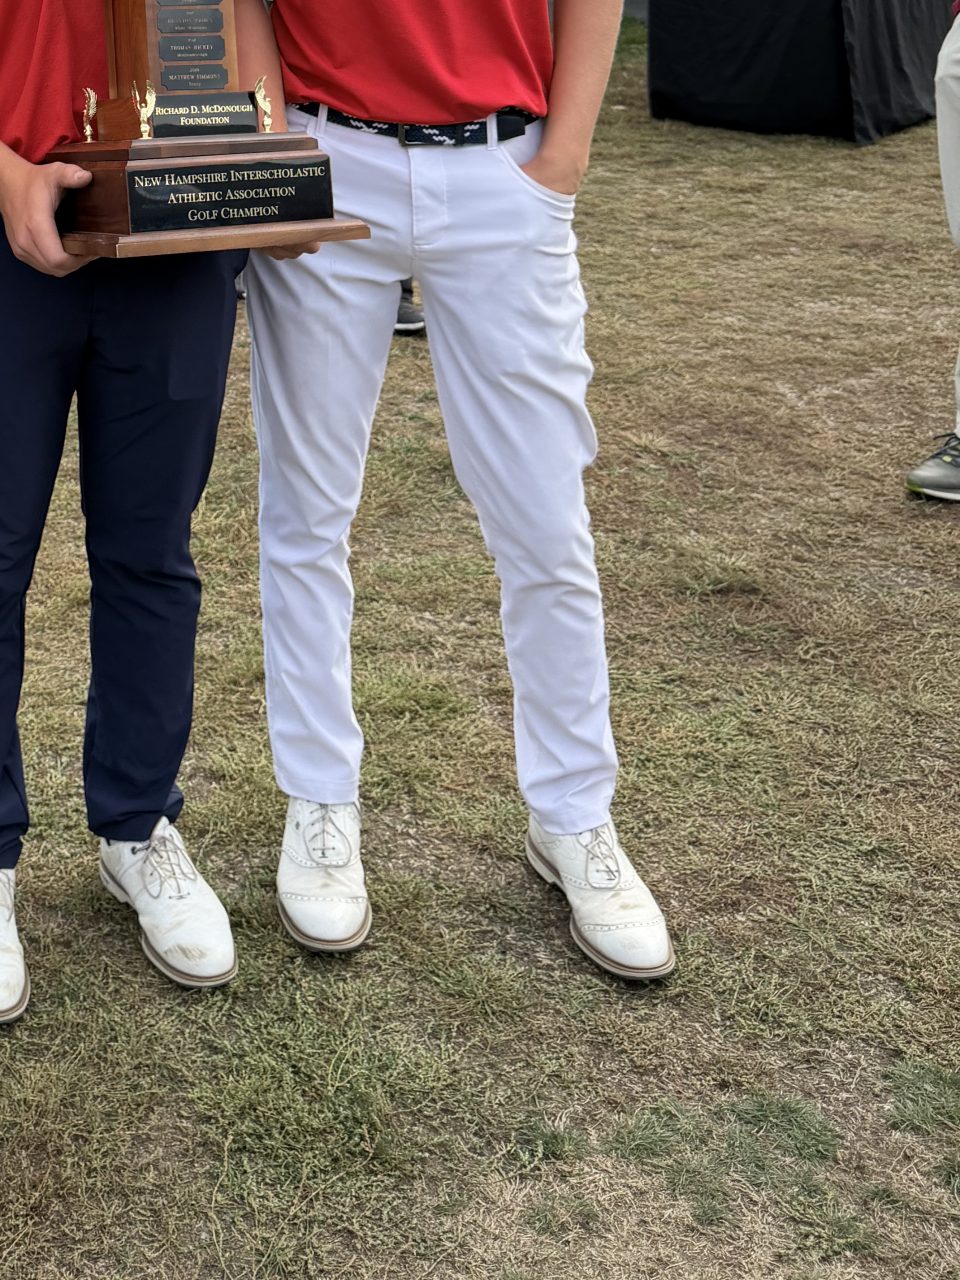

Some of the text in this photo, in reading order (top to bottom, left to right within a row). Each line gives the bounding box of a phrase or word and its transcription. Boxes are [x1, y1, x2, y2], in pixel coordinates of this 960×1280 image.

[155, 106, 189, 116] RICHARD
[191, 105, 200, 114] D.
[180, 116, 230, 126] FOUNDATION
[134, 166, 325, 188] NEW HAMPSHIRE INTERSCHOLASTIC
[168, 187, 296, 204] ATHLETIC ASSOCIATION
[187, 206, 279, 221] GOLF CHAMPION
